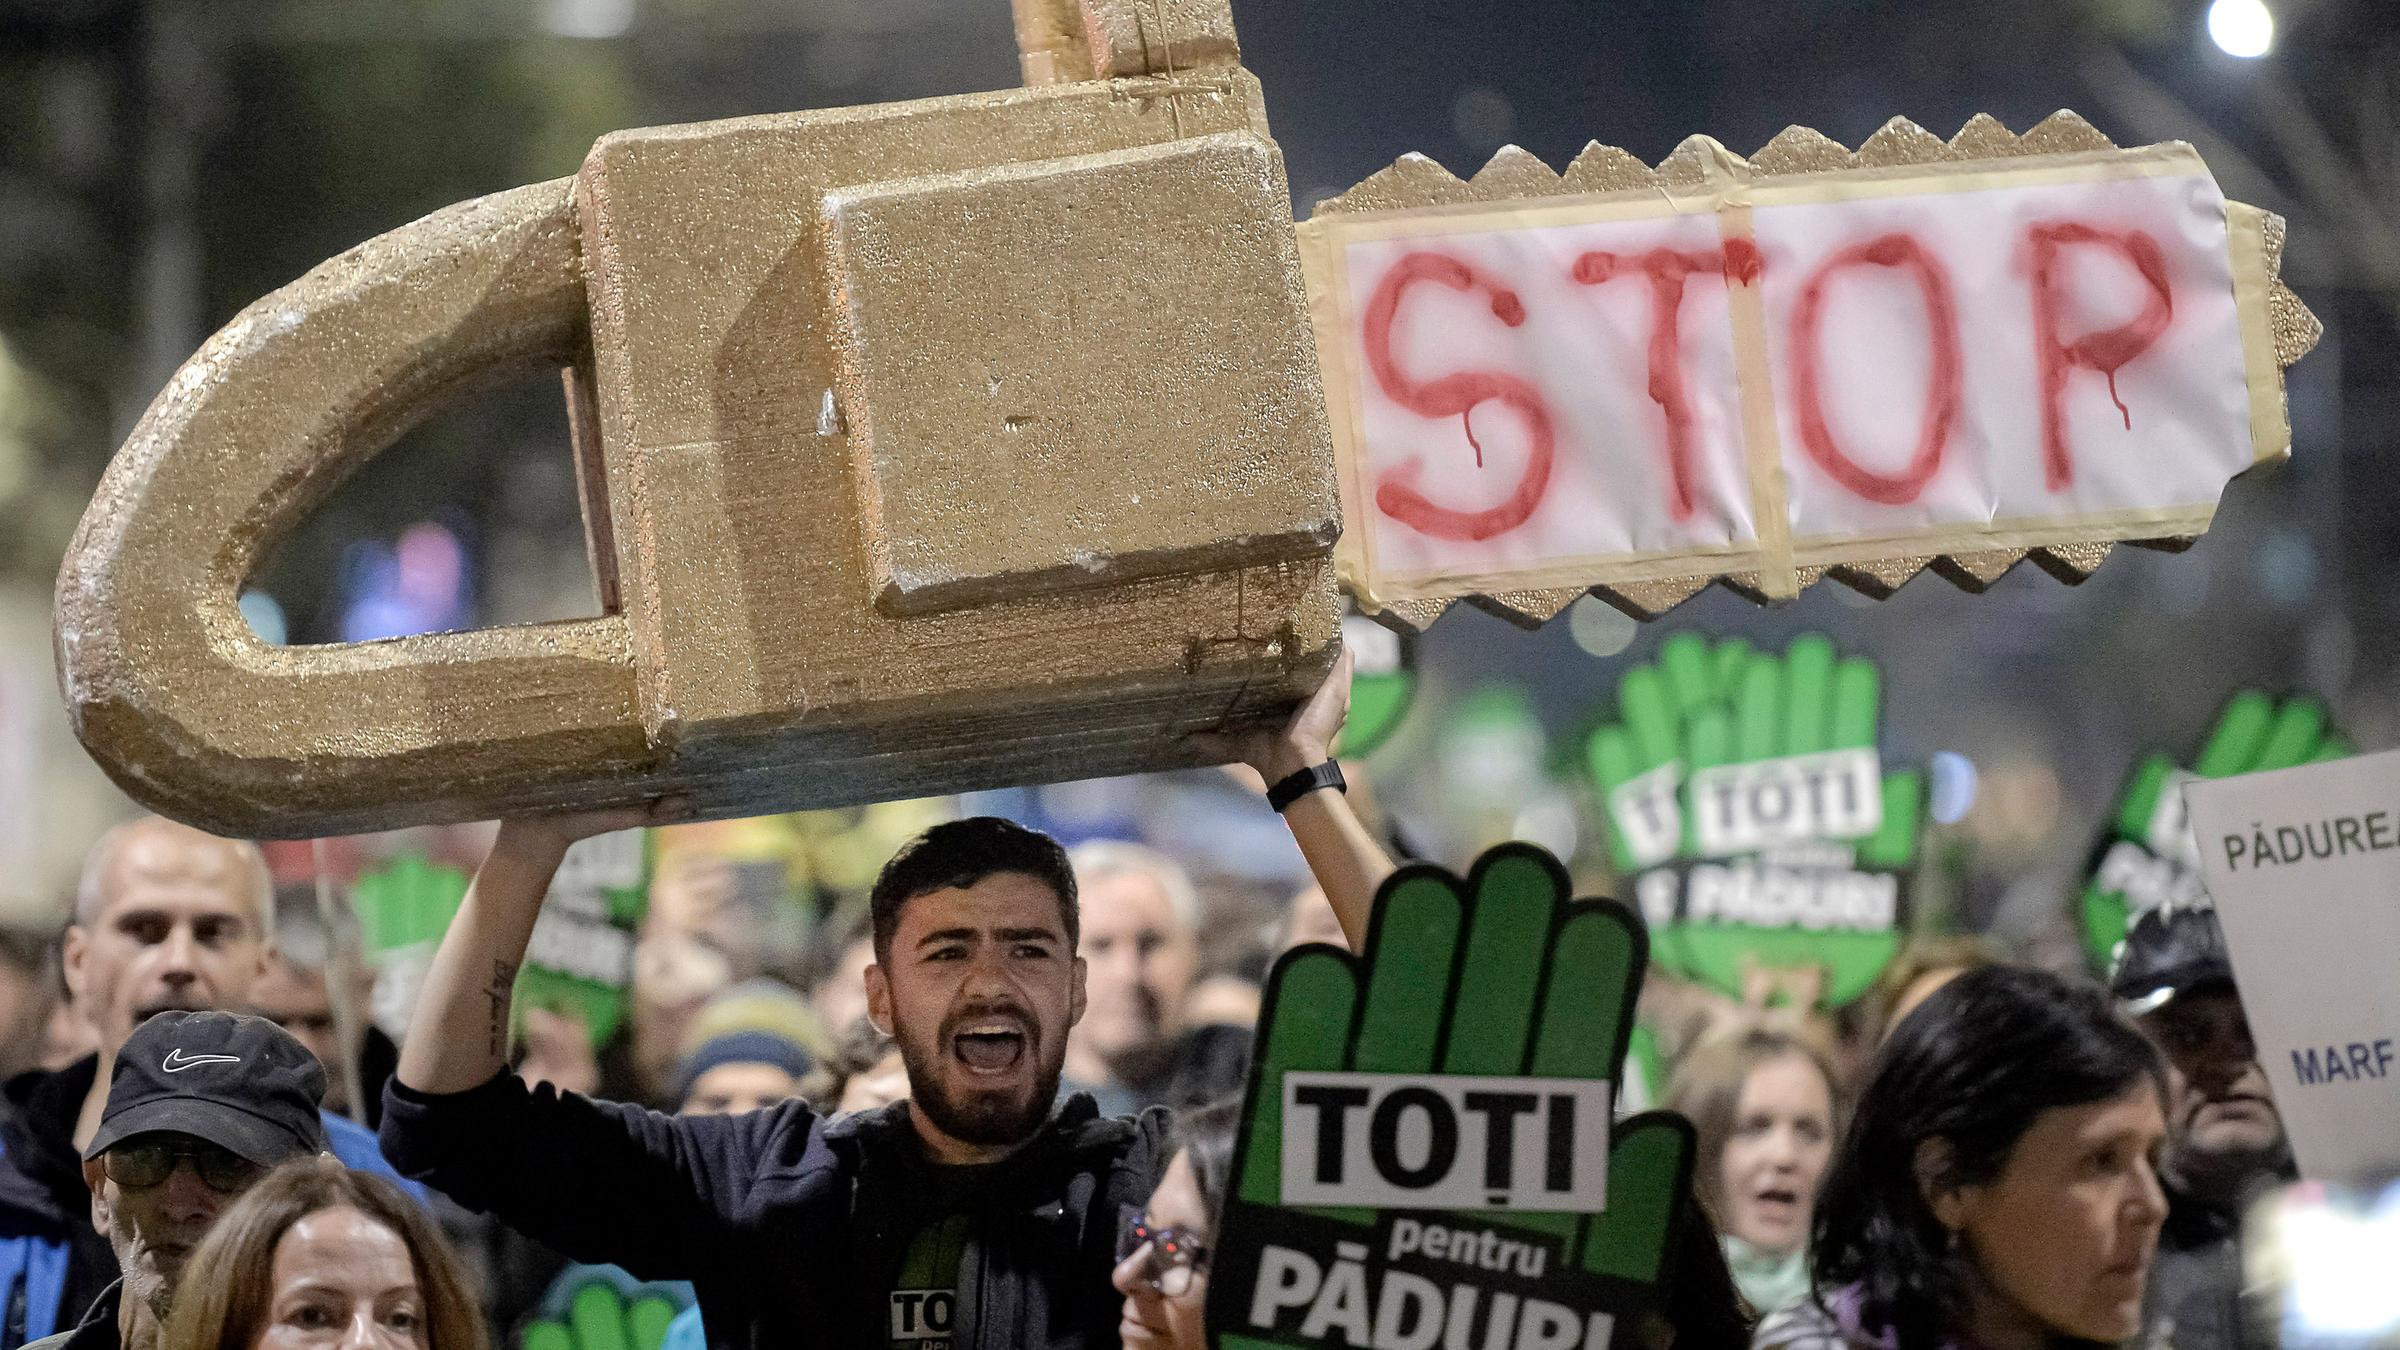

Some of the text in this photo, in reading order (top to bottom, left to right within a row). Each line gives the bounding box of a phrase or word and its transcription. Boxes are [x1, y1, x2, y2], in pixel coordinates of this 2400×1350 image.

[1363, 222, 2174, 542] STOP
[2223, 811, 2400, 872] PĂDURE
[2291, 1039, 2393, 1085] MARF
[1295, 1086, 1577, 1205] TOȚI
[1387, 1218, 1548, 1279] pentru
